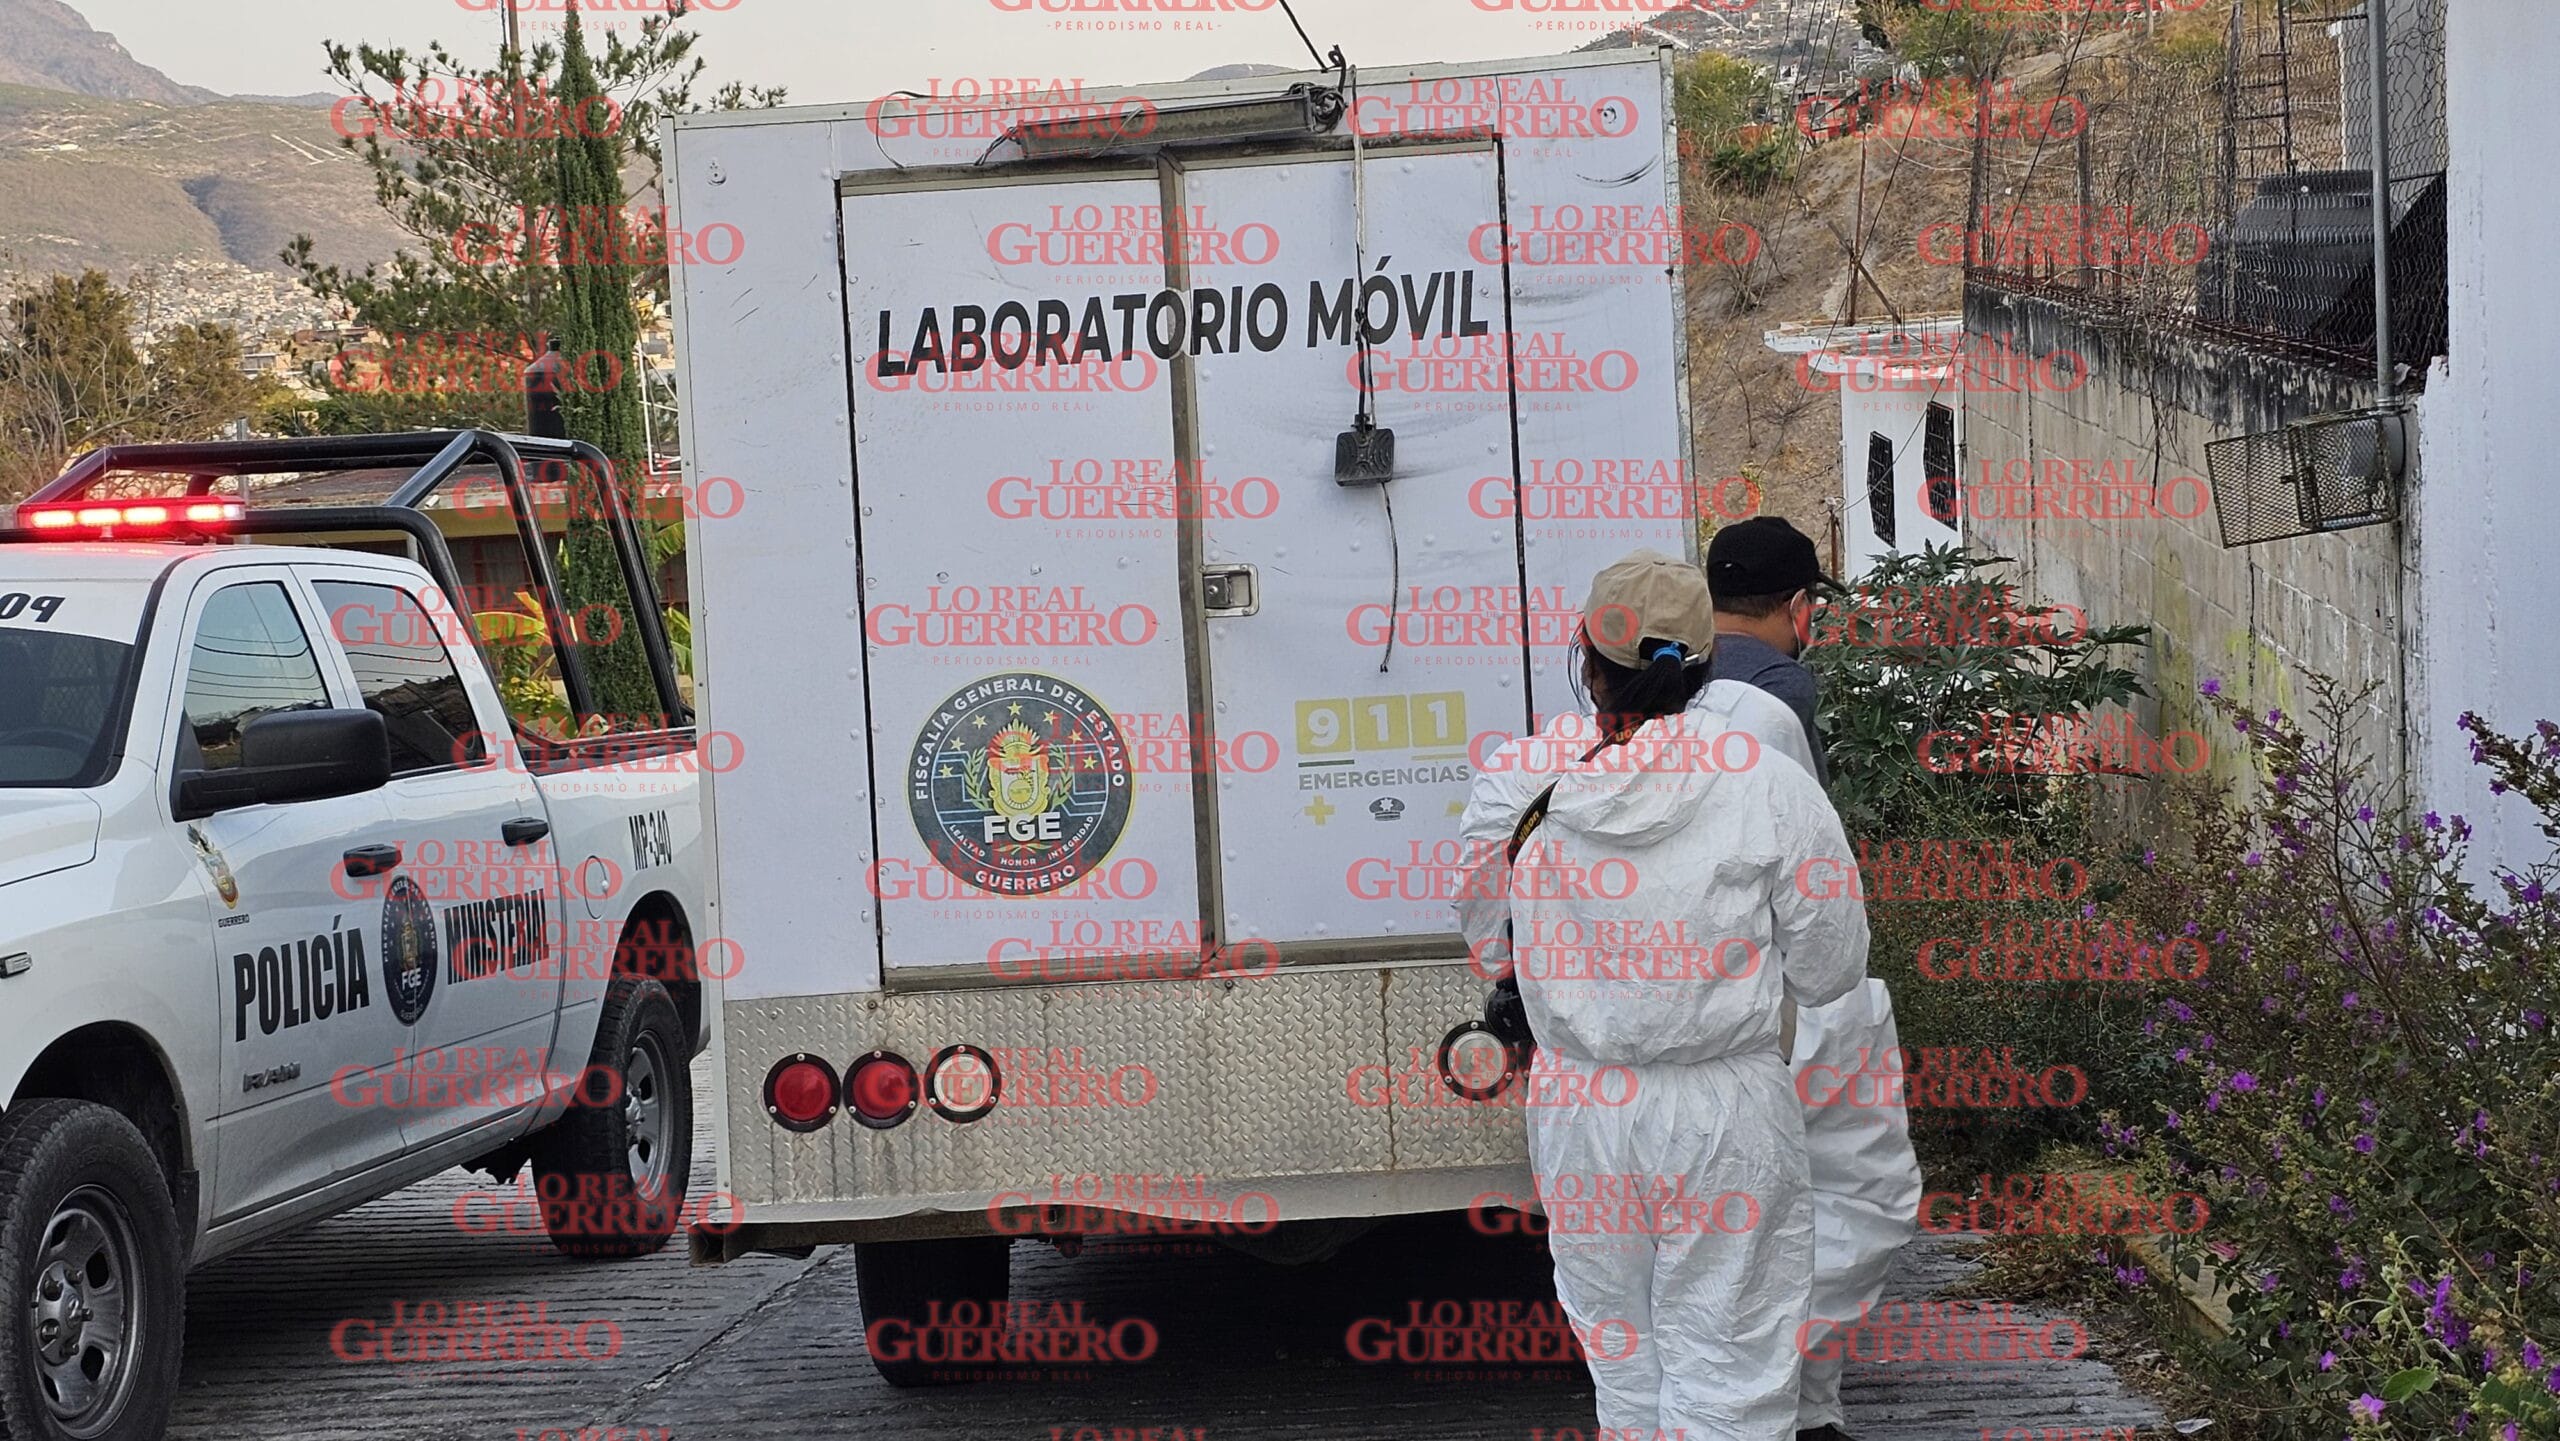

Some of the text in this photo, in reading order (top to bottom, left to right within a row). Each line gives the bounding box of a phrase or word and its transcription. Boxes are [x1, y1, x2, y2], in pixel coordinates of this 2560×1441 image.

[877, 255, 1489, 378] LABORATORIO MÓVIL
[914, 678, 1125, 800] FISCALÍA GENERAL DEL ESTADO
[1308, 700, 1448, 747] 911
[1299, 765, 1470, 790] EMERGENCIAS
[629, 810, 672, 871] MP-340
[949, 815, 1094, 866] LEALTAD HONOR INTEGRIDAD
[983, 812, 1062, 844] FGE
[1518, 810, 1540, 843] Nikon
[975, 864, 1076, 890] GUERRERO
[233, 914, 370, 1042] POLICÍA
[444, 888, 549, 985] MINISTERIAL
[401, 967, 422, 991] FGE
